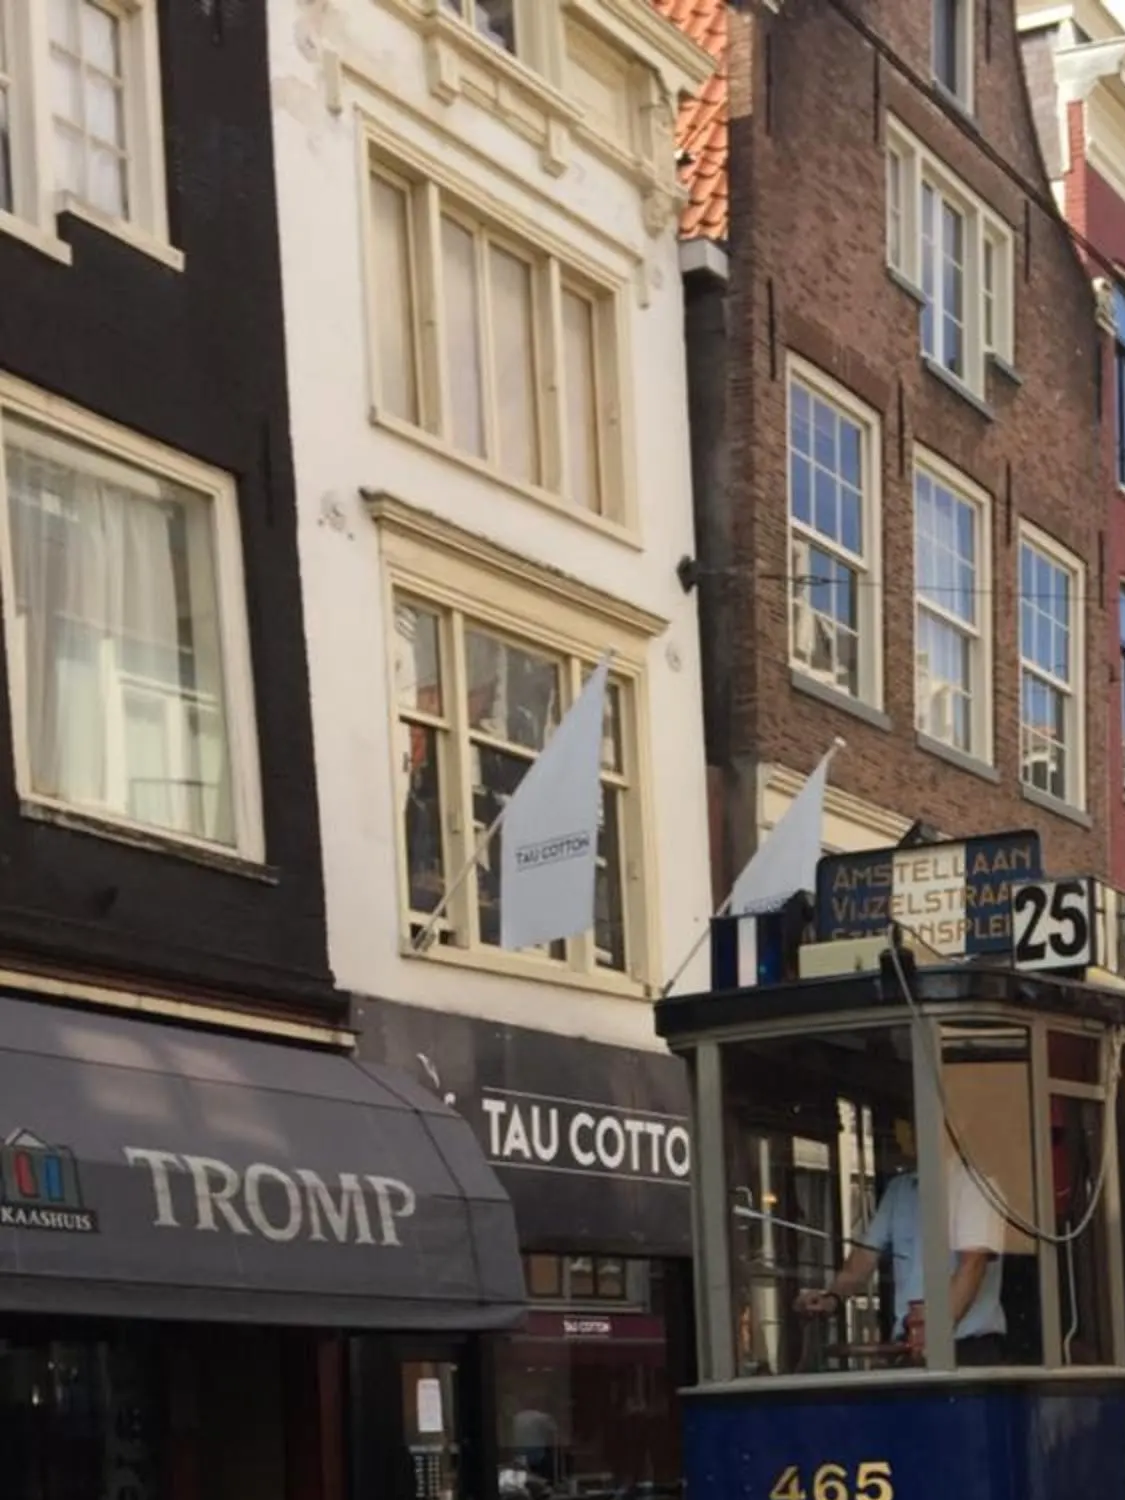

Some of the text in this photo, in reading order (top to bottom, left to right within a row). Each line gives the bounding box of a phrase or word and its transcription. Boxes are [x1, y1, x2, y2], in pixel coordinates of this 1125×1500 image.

[516, 837, 589, 864] TAU COTTON
[832, 846, 1032, 893] AMSTELLAAN
[832, 882, 1010, 922] VIJZELSTRAA
[1015, 882, 1087, 961] 25
[482, 1098, 690, 1177] TAU COTTO
[1, 1206, 92, 1231] KAASHUIS
[124, 1146, 416, 1246] TROMP
